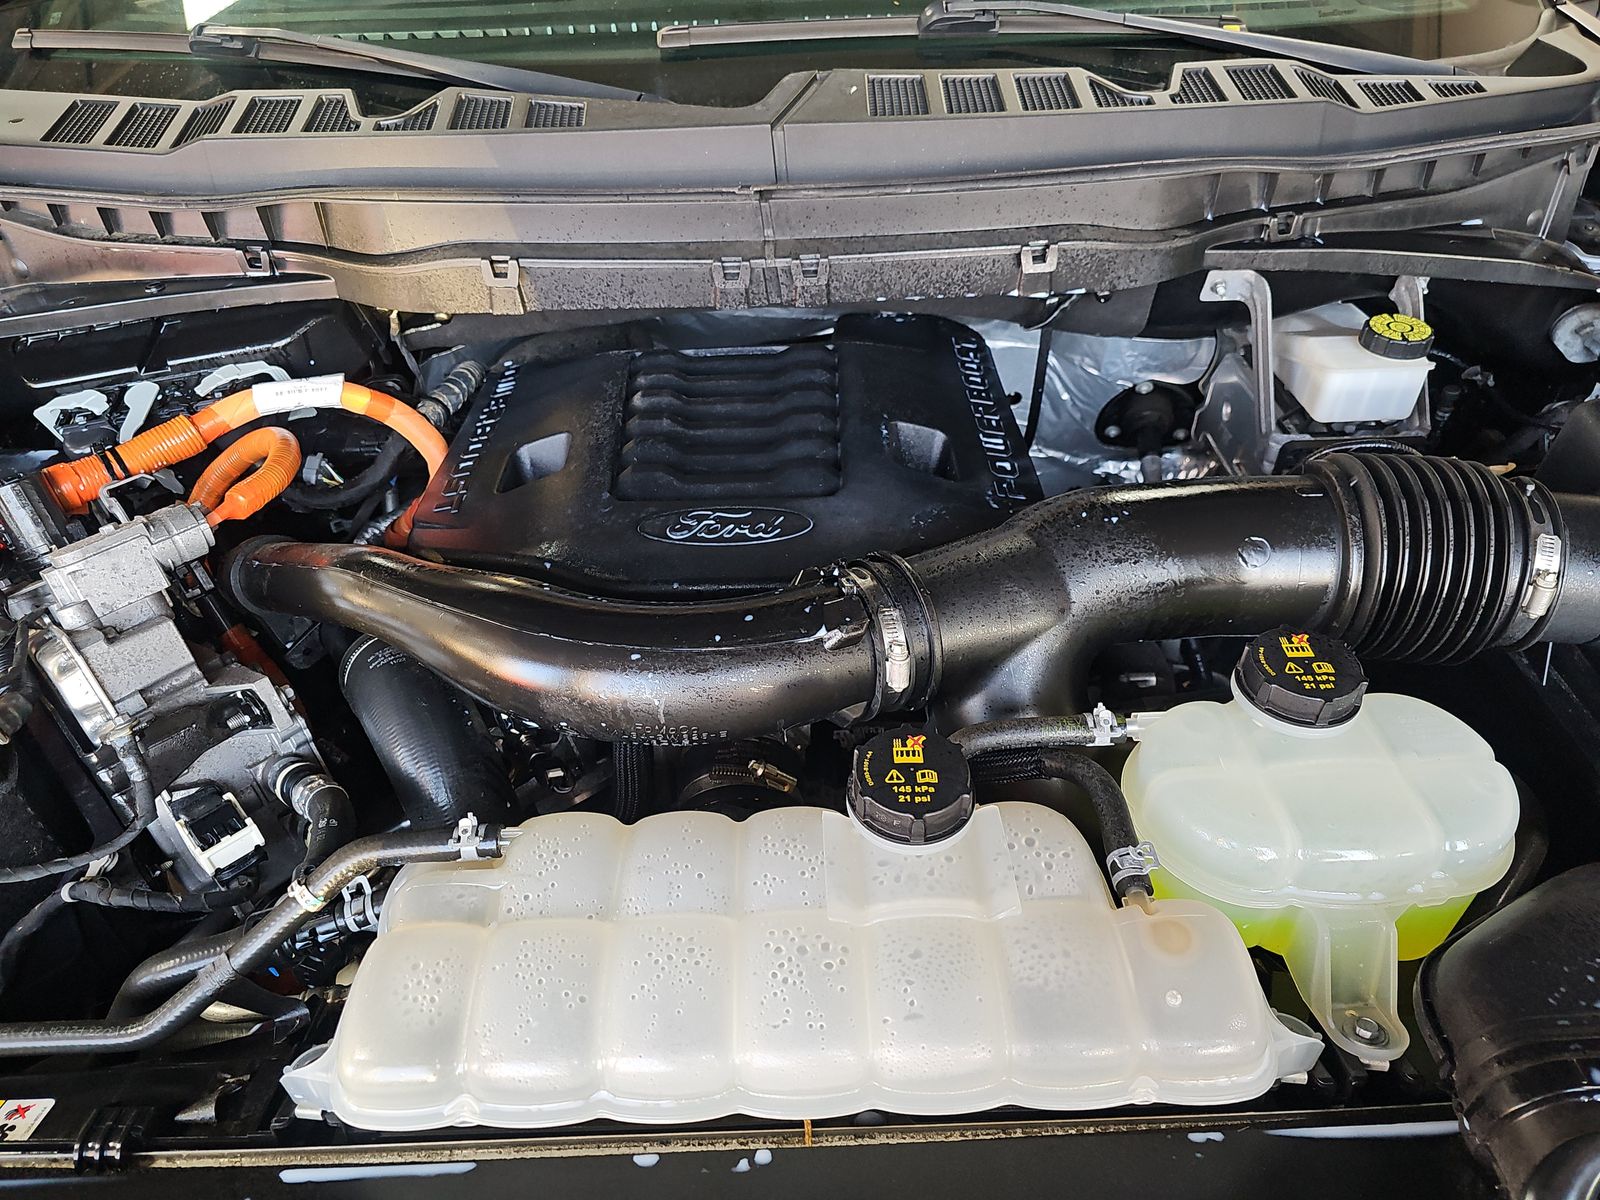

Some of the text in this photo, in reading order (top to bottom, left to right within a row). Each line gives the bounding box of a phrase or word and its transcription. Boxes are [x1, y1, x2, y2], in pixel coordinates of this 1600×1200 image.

[666, 511, 785, 539] Ford
[1319, 682, 1335, 690] psi
[892, 785, 936, 793] 145 kPa
[898, 794, 931, 804] 21 psi
